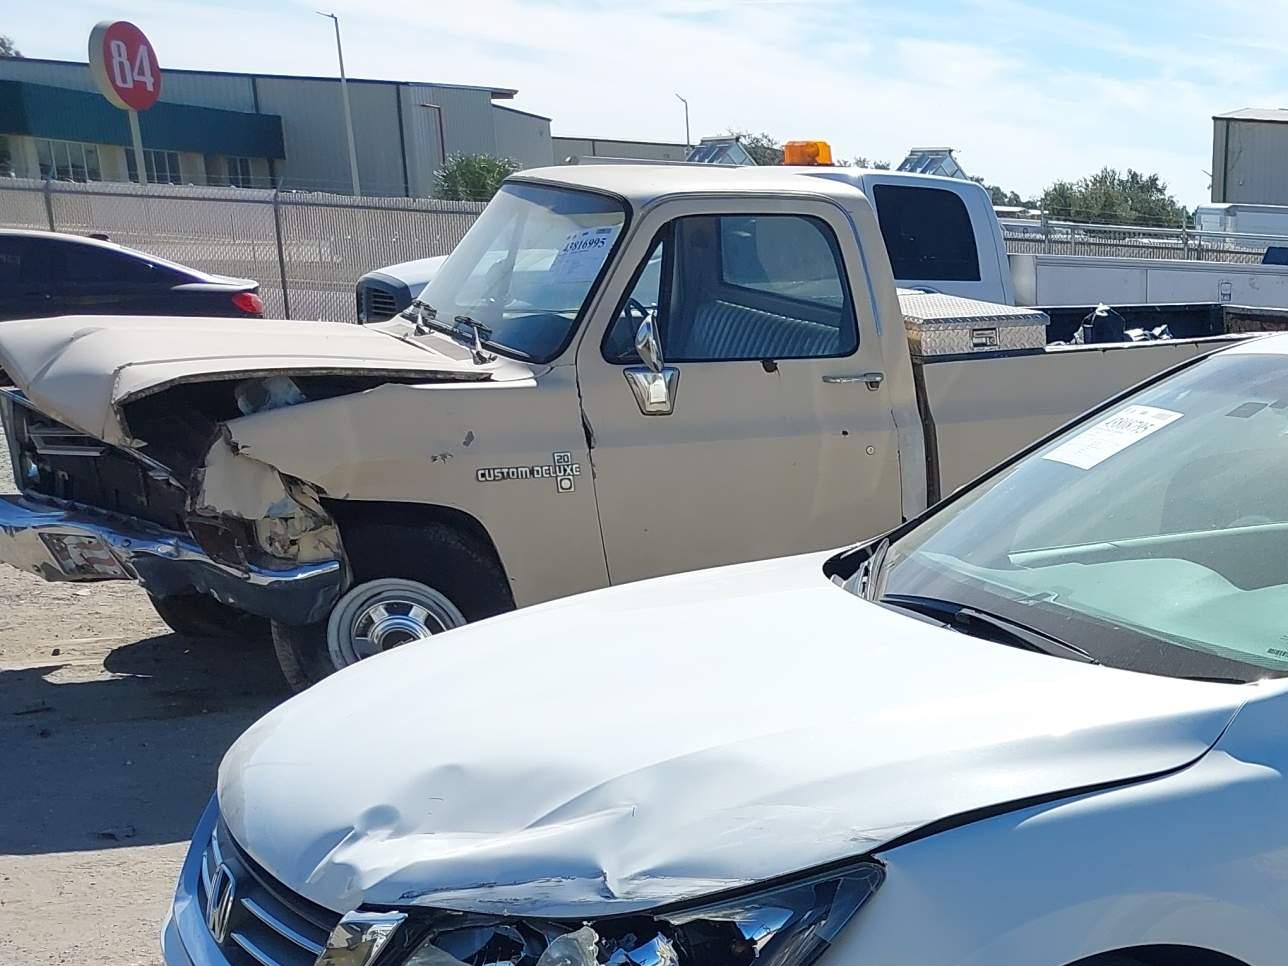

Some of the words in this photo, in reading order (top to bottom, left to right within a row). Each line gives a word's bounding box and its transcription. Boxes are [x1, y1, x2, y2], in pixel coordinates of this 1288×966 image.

[111, 40, 154, 92] 84
[556, 454, 570, 464] 20
[477, 467, 530, 481] CUSTOM
[533, 464, 580, 478] DELUXE
